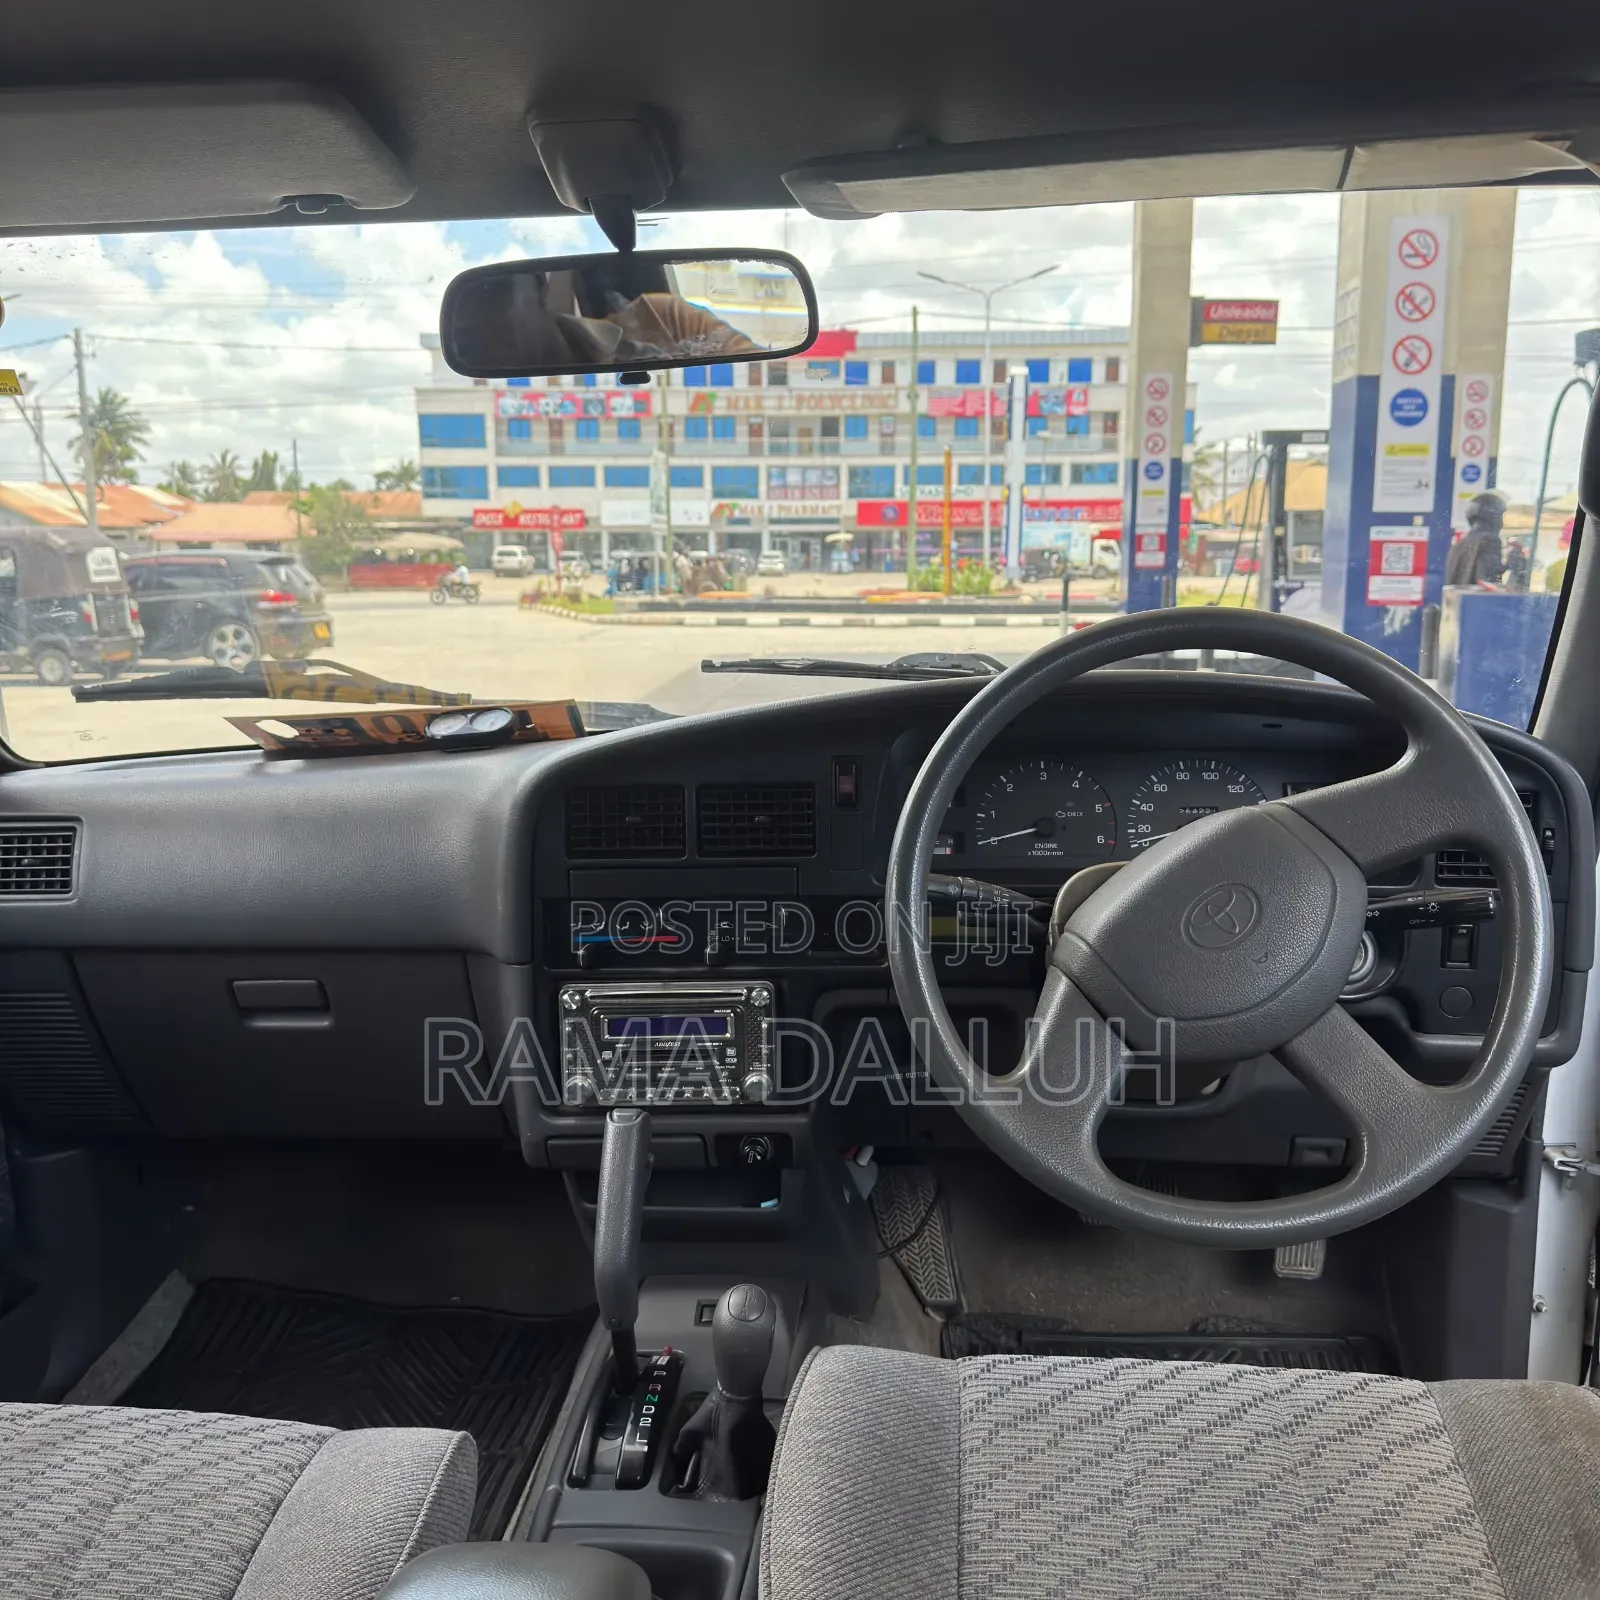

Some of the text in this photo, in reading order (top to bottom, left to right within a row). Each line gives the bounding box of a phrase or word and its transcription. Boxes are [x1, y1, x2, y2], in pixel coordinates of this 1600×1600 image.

[1040, 772, 1047, 780] 3
[1176, 772, 1220, 780] 80 100
[1006, 783, 1014, 792] 2
[1072, 780, 1080, 789] 4
[1154, 784, 1168, 792] 60
[1226, 785, 1244, 793] 120
[1095, 804, 1103, 813] 5
[1140, 804, 1154, 812] 40
[990, 810, 996, 819] 1
[1137, 825, 1152, 833] 20
[1097, 835, 1105, 844] 6
[645, 1394, 659, 1402] N
[642, 1405, 655, 1414] D
[639, 1417, 652, 1426] 2
[636, 1432, 648, 1443] L
